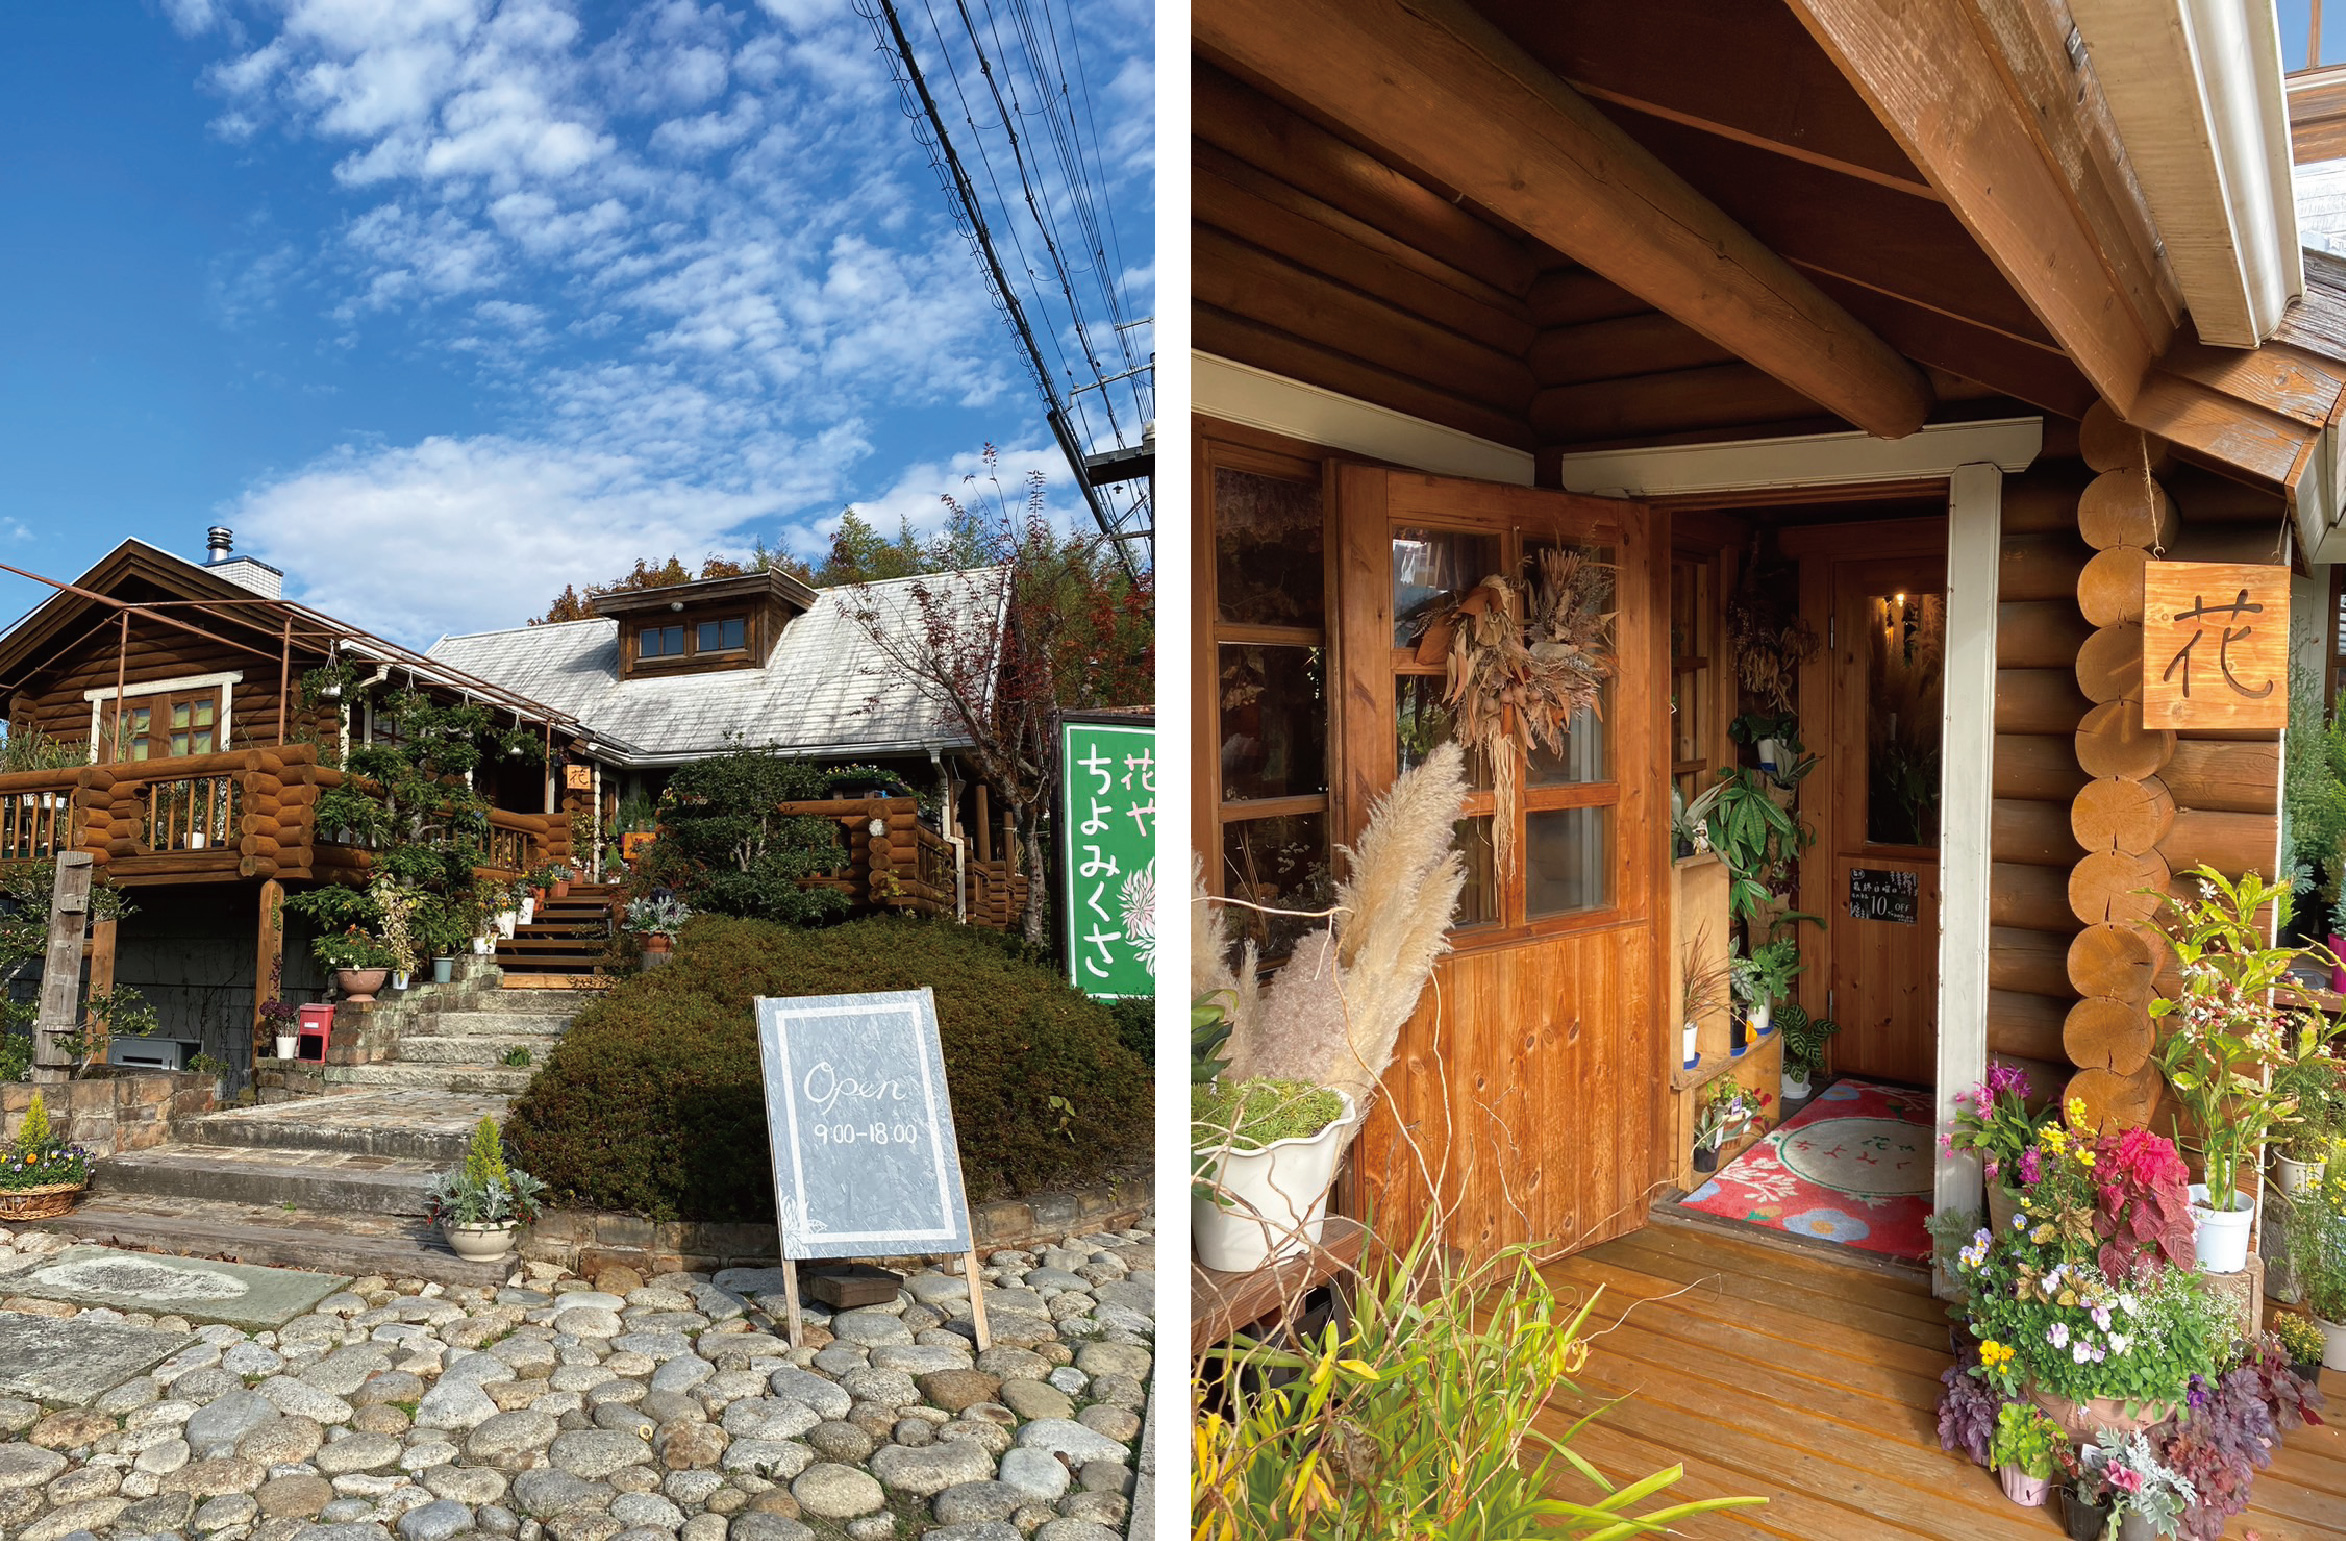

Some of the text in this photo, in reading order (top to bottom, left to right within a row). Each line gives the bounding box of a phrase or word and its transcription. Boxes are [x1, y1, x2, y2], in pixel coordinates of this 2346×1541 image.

[2163, 588, 2274, 699] 花
[569, 768, 589, 786] 花
[1077, 743, 1122, 978] ちよみくさ
[1894, 903, 1911, 913] OFF
[803, 1061, 907, 1116] Open
